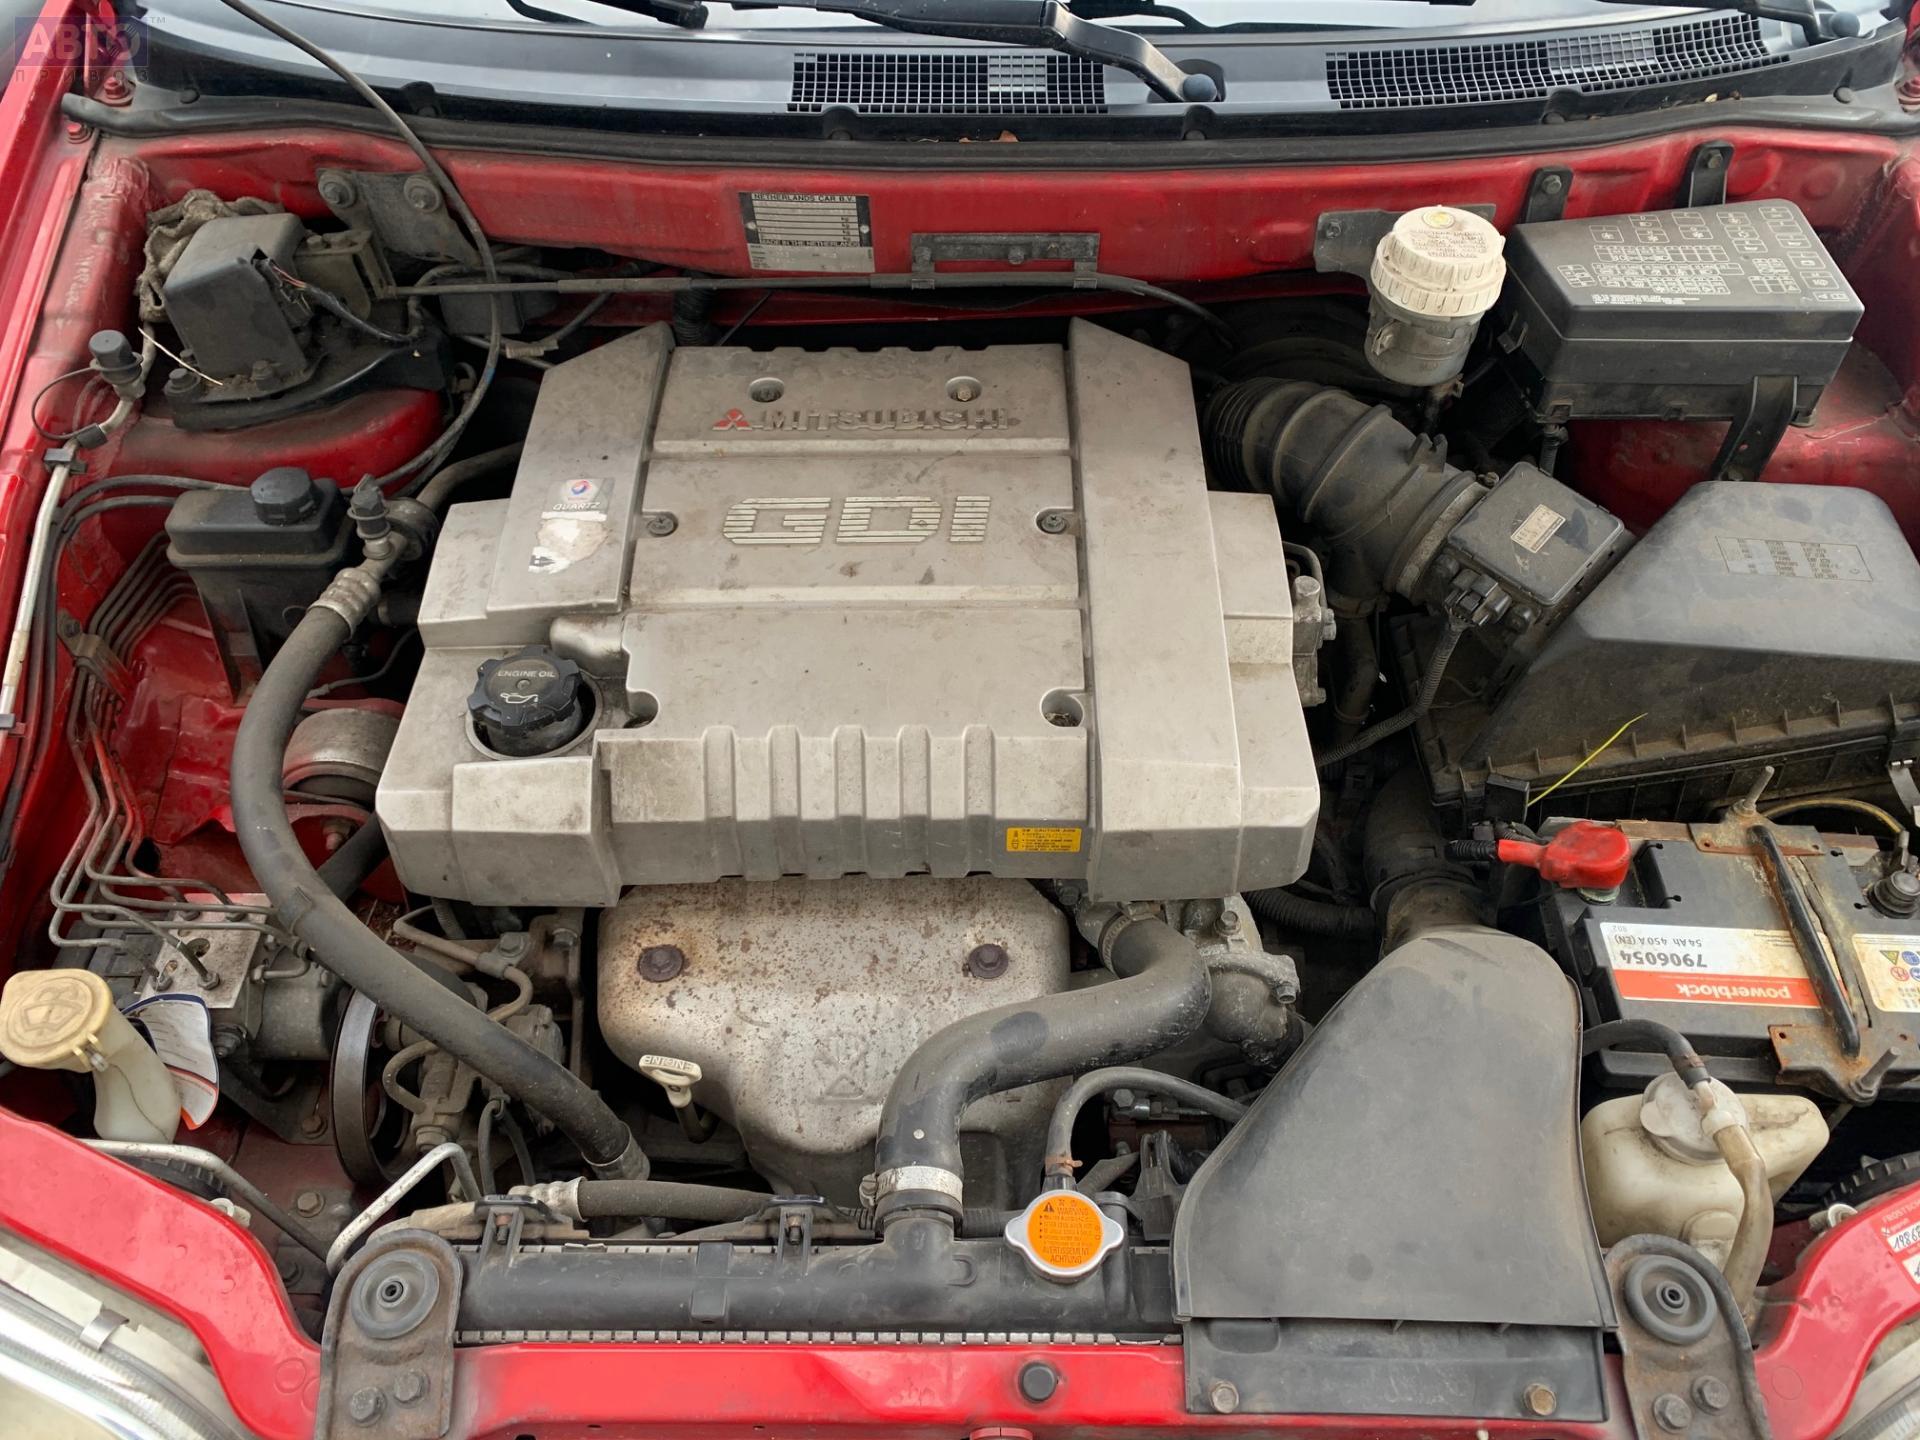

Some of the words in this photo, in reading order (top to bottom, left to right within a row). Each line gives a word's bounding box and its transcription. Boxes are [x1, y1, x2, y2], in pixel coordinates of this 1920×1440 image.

[763, 408, 1010, 431] MITSUBISHI
[552, 502, 600, 511] QUARTZ
[723, 496, 991, 544] GDI
[497, 670, 536, 678] ENGINE
[538, 670, 556, 678] OIL
[1615, 934, 1635, 945] (EN)
[1620, 950, 1707, 968] 7906054
[1675, 983, 1792, 999] powerblock
[1056, 1207, 1088, 1215] WARNING
[1050, 1255, 1082, 1264] ACHTUNG
